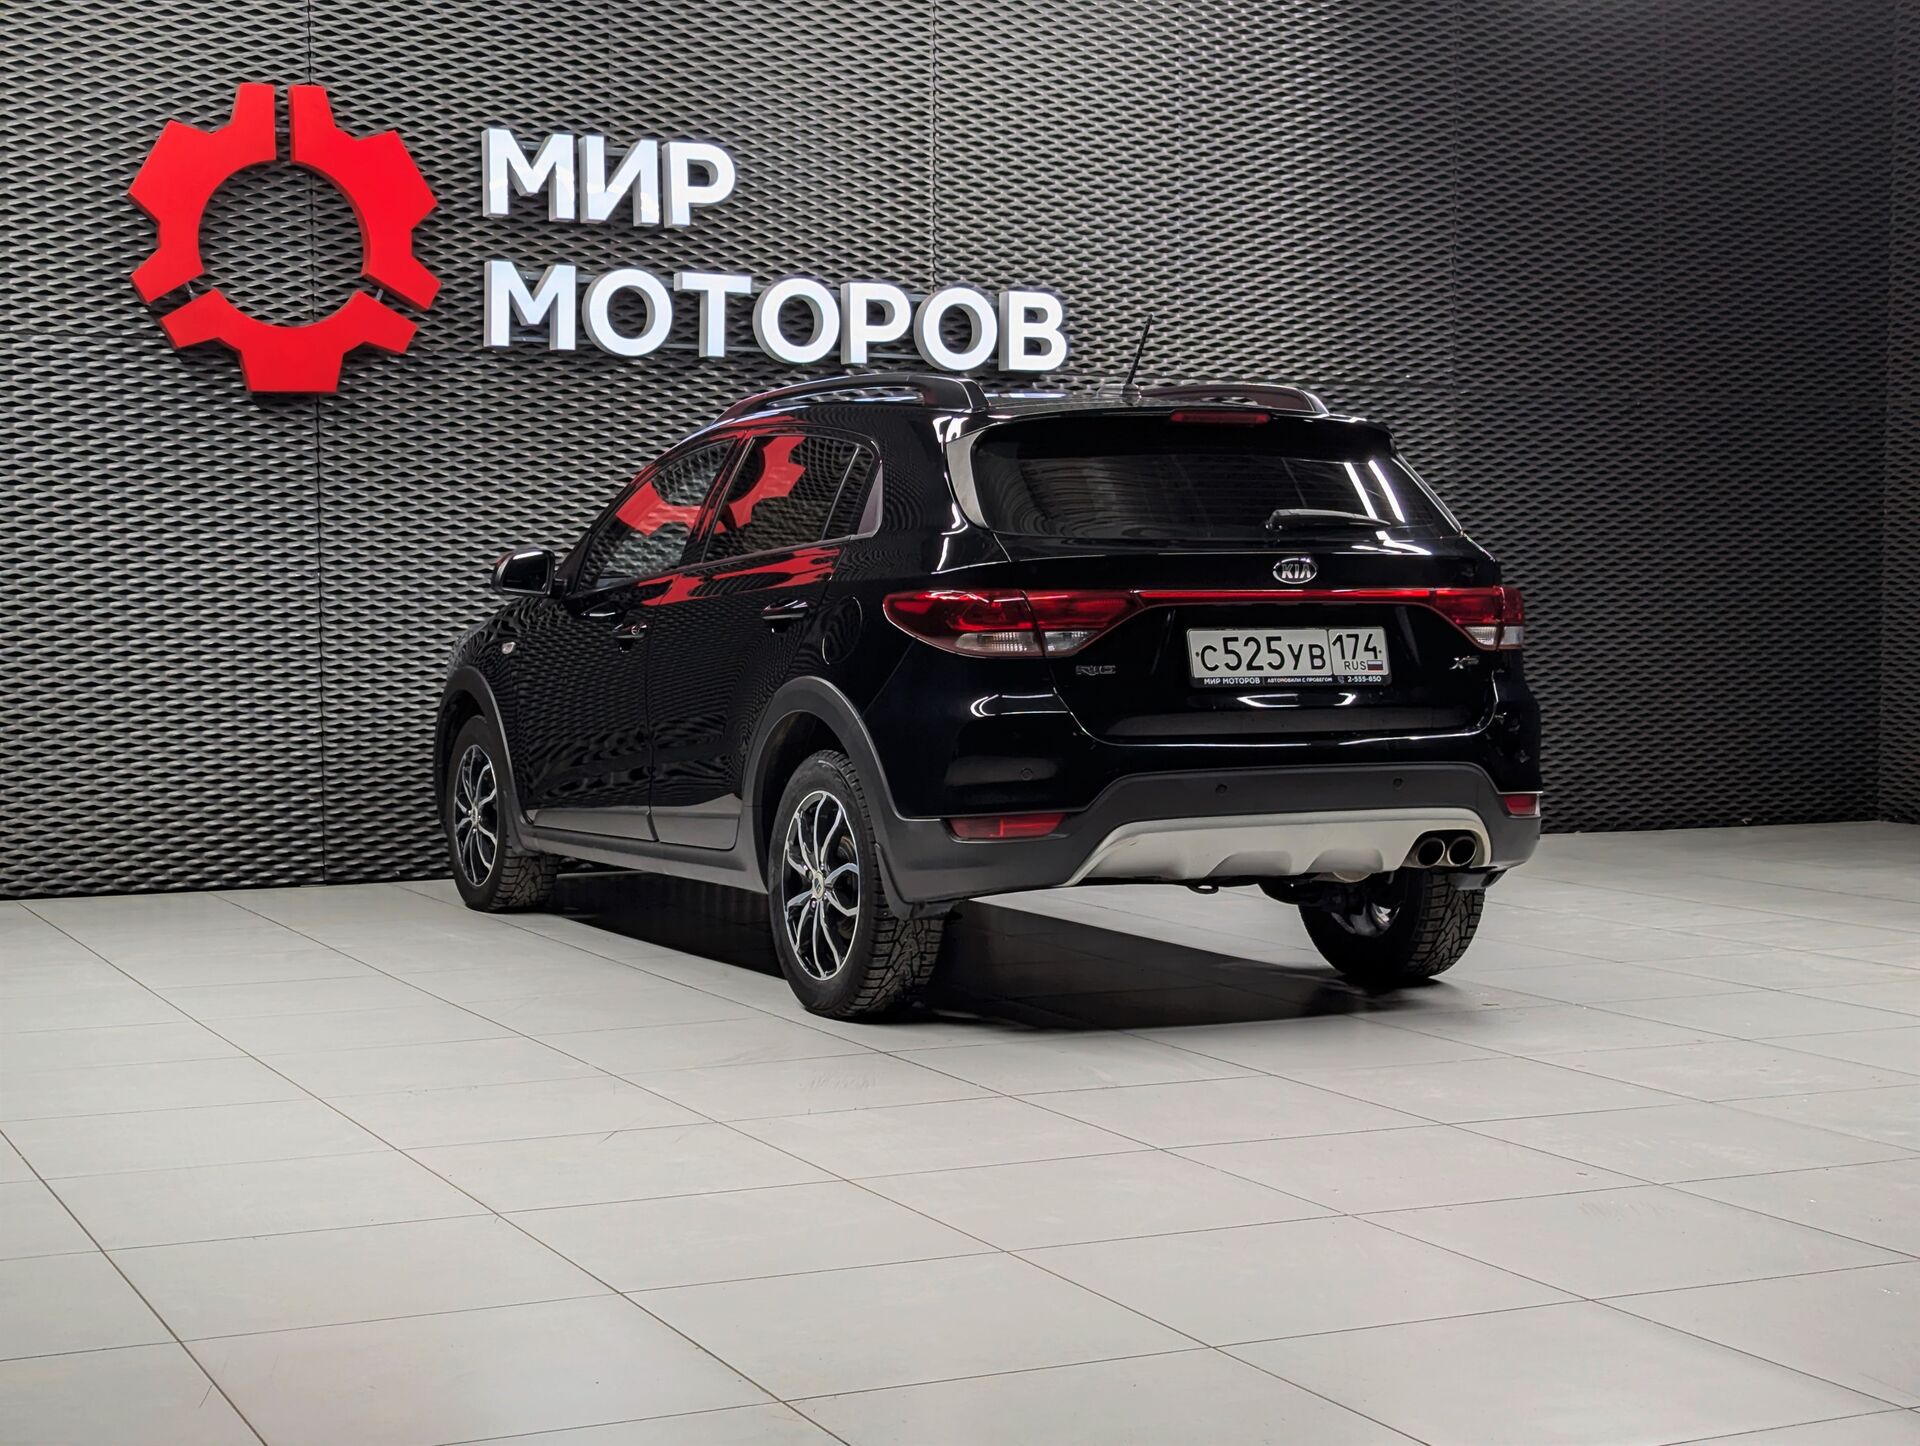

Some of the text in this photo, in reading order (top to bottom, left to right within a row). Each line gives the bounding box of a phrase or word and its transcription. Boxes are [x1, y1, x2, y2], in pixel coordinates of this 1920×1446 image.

[481, 128, 736, 229] МИР
[484, 260, 1068, 372] МОТОРОВ
[1281, 563, 1311, 579] KIA
[1332, 633, 1379, 660] 174
[1344, 660, 1367, 671] RUS
[1204, 677, 1221, 685] МИР
[1222, 677, 1261, 685] МОТОРОВ
